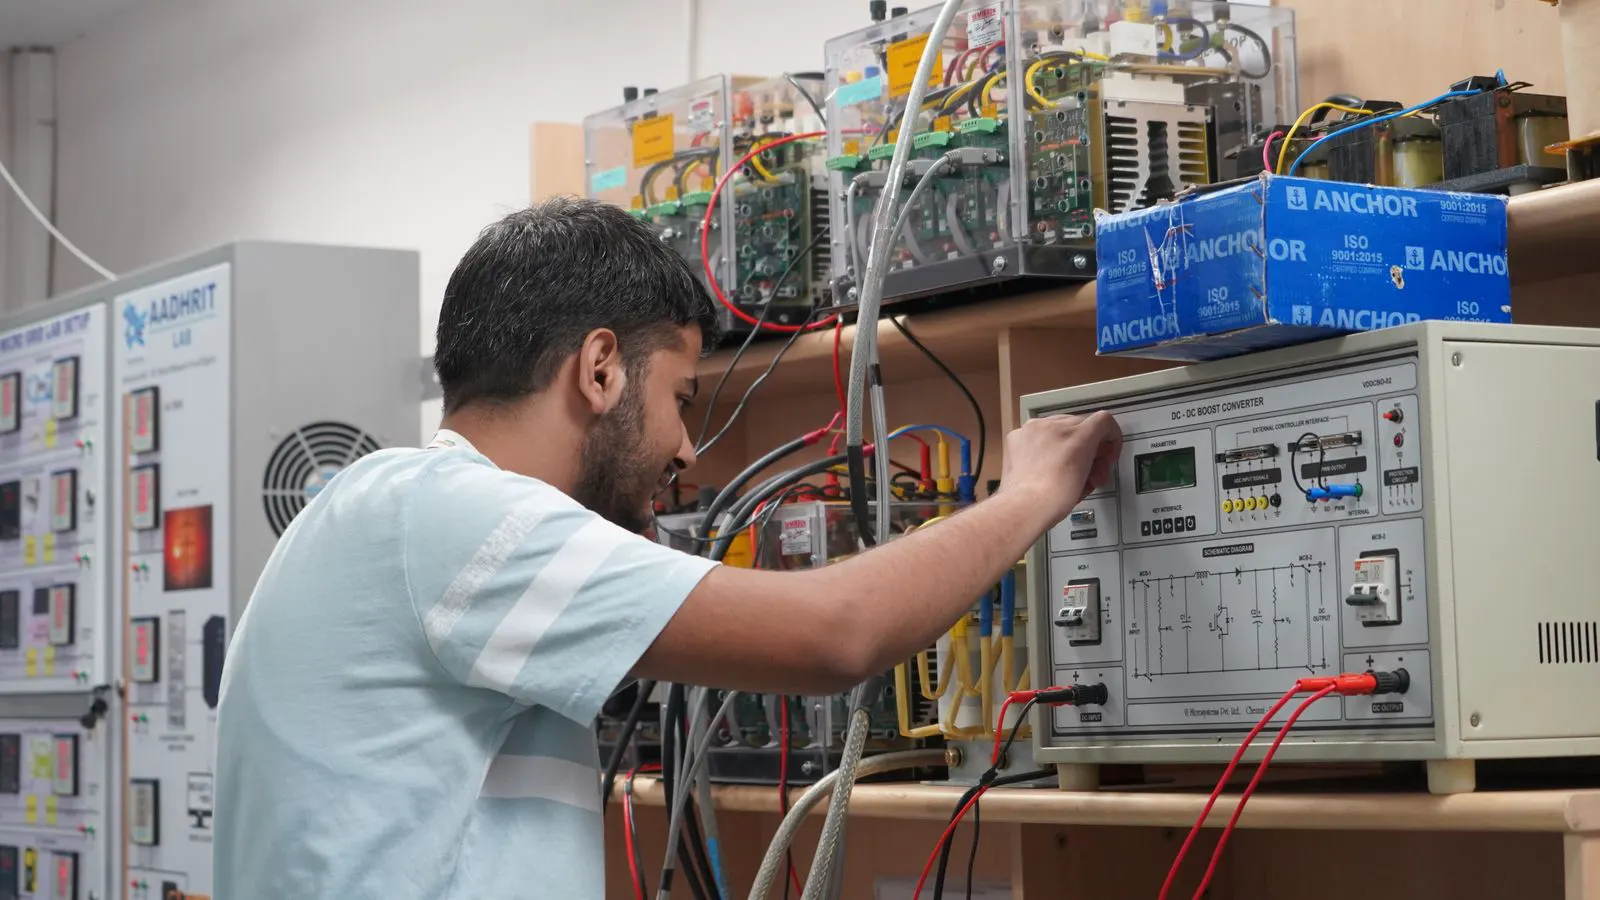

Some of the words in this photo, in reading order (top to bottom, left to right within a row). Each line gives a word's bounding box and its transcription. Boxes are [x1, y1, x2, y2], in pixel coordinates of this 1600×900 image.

[1314, 189, 1418, 217] ANCHOR
[1441, 200, 1487, 213] 9001:2015
[1344, 234, 1369, 249] ISO
[1118, 249, 1136, 265] ISO
[1332, 250, 1383, 263] 9001:2015
[1108, 261, 1147, 279] 9001:2015
[1208, 287, 1228, 303] ISO
[151, 284, 216, 323] AADHRIT
[1197, 300, 1240, 317] 9001:2015
[1457, 301, 1480, 315] ISO
[1101, 311, 1179, 347] ANCHOR
[173, 330, 192, 349] LAB
[1171, 411, 1181, 421] DC
[1187, 408, 1196, 418] DC
[1197, 404, 1221, 416] BOOST
[1222, 397, 1265, 413] CONVERTER
[1252, 425, 1275, 434] EXTERNAL
[1275, 420, 1305, 430] CONTROLLER
[1305, 416, 1330, 426] INTERFACE
[1150, 440, 1177, 449] PARAMETERS
[1204, 547, 1231, 557] SCHEMATIC
[1231, 544, 1254, 554] DIAGRAM
[1312, 614, 1331, 622] OUTPUT
[1382, 703, 1403, 711] OUTPUT
